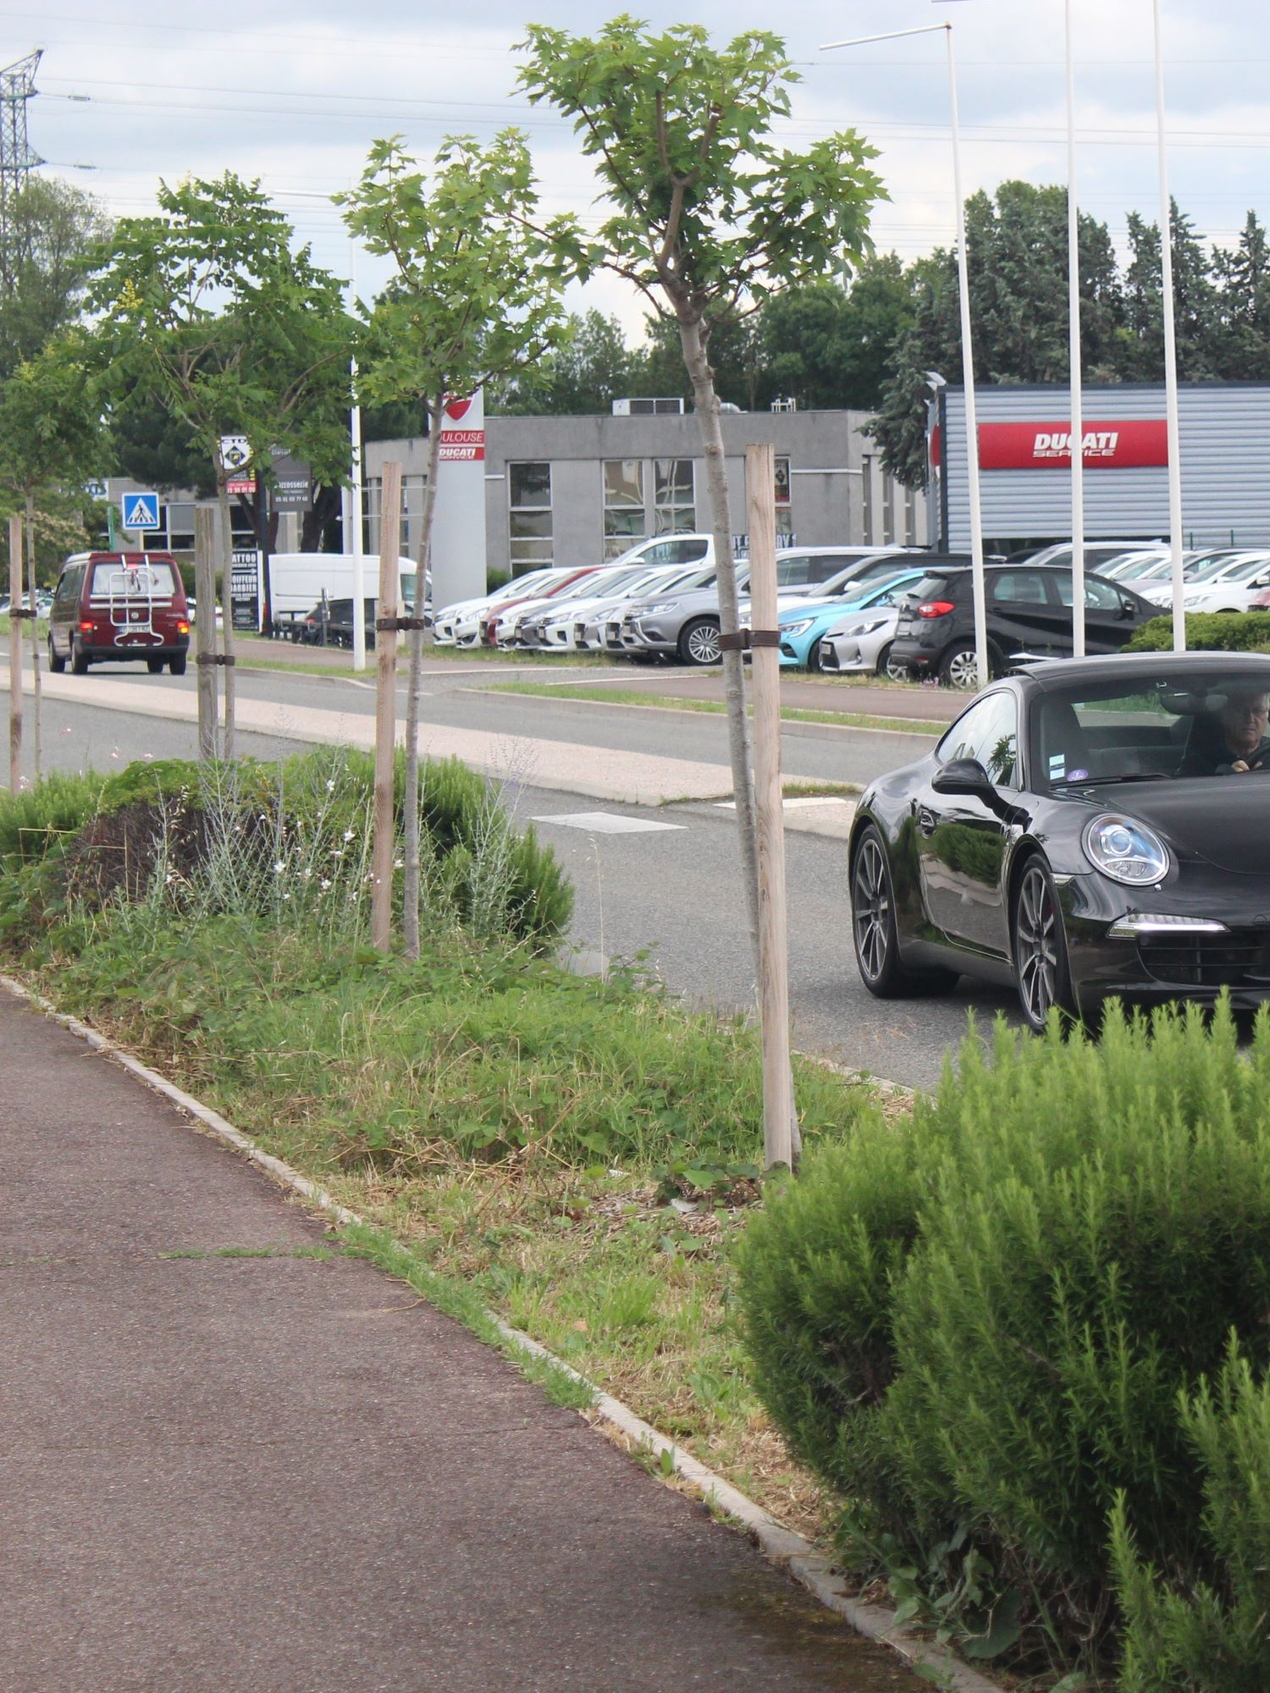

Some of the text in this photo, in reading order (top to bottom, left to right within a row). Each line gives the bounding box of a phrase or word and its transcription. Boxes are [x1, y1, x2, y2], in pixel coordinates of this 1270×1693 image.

[439, 448, 476, 457] DUCATI
[231, 553, 257, 562] ATTOO
[232, 575, 257, 584] OIFFEUR
